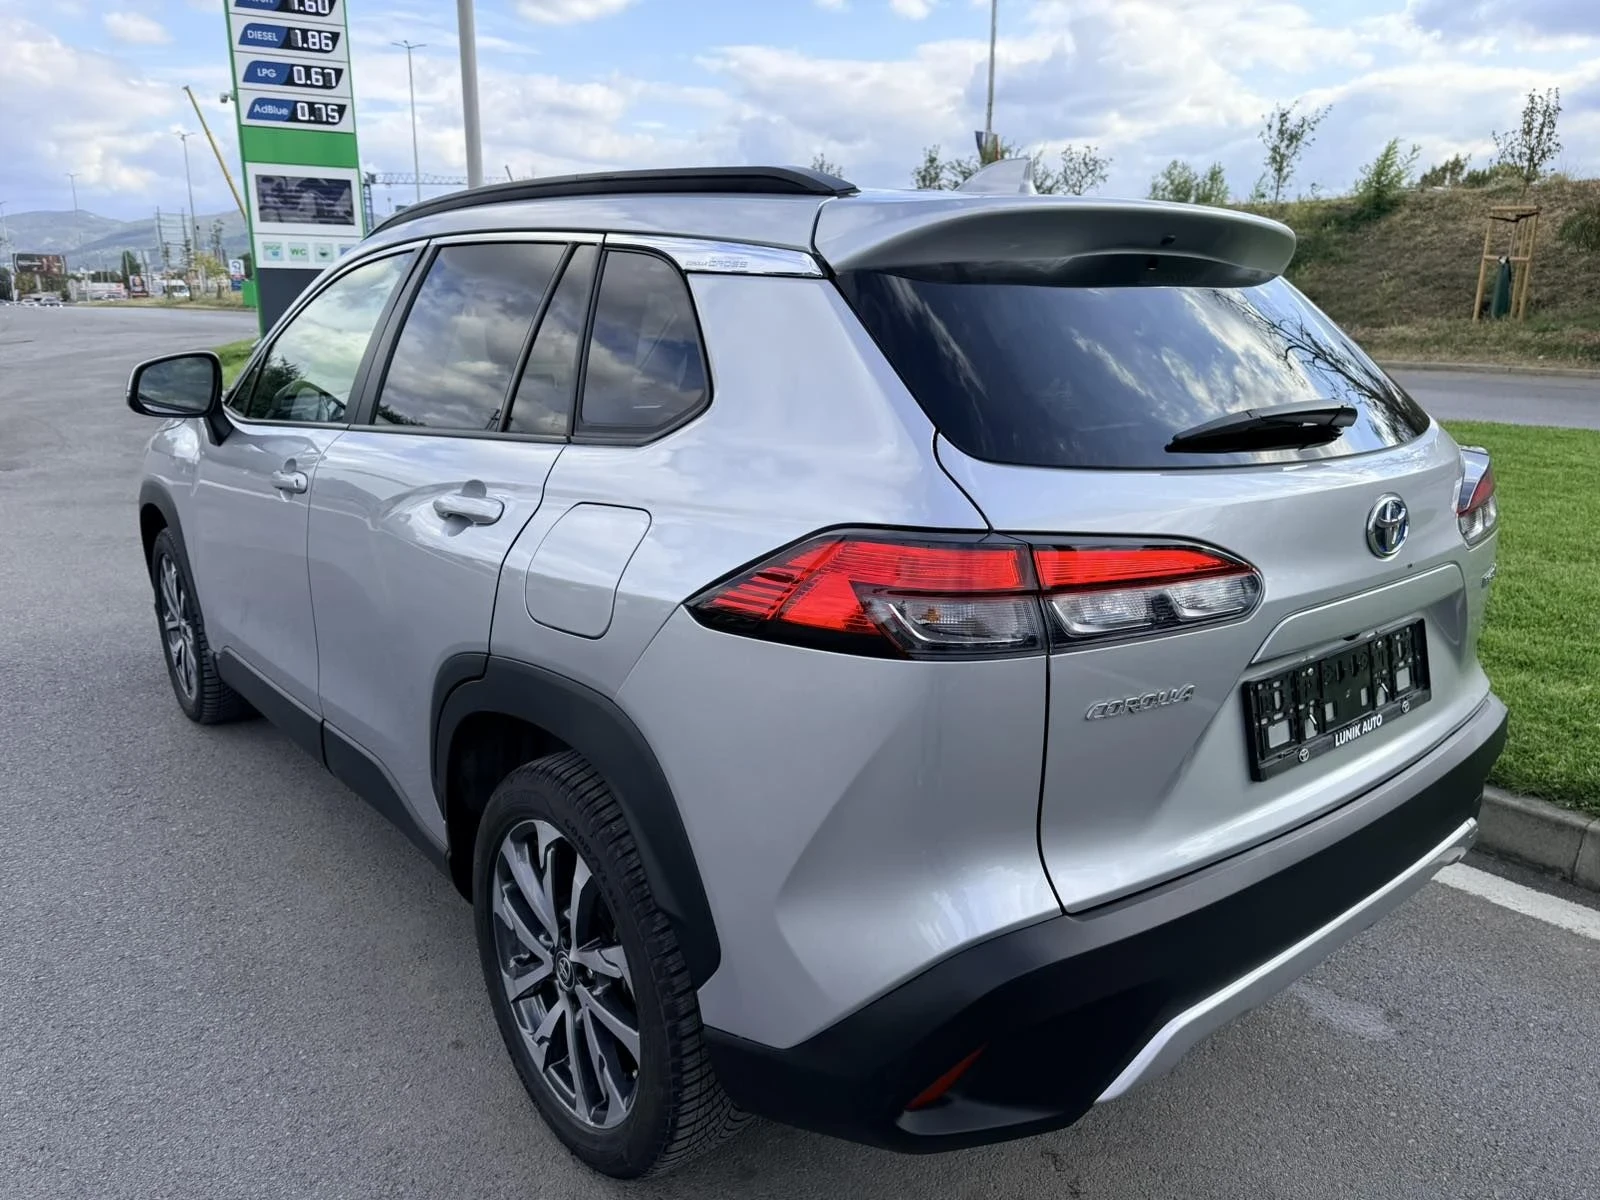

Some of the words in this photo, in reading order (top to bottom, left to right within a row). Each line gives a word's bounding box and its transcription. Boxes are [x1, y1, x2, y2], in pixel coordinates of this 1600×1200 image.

[247, 30, 279, 42] DIESEL
[295, 29, 333, 51] 1.86
[257, 68, 277, 78] LPG
[293, 66, 336, 87] 0.67
[253, 104, 289, 115] AdBlue
[297, 102, 340, 123] 0.75
[290, 248, 307, 256] WC
[1085, 683, 1195, 720] COROLLA
[1335, 723, 1361, 747] LUNIK
[1362, 713, 1383, 735] AUTO
